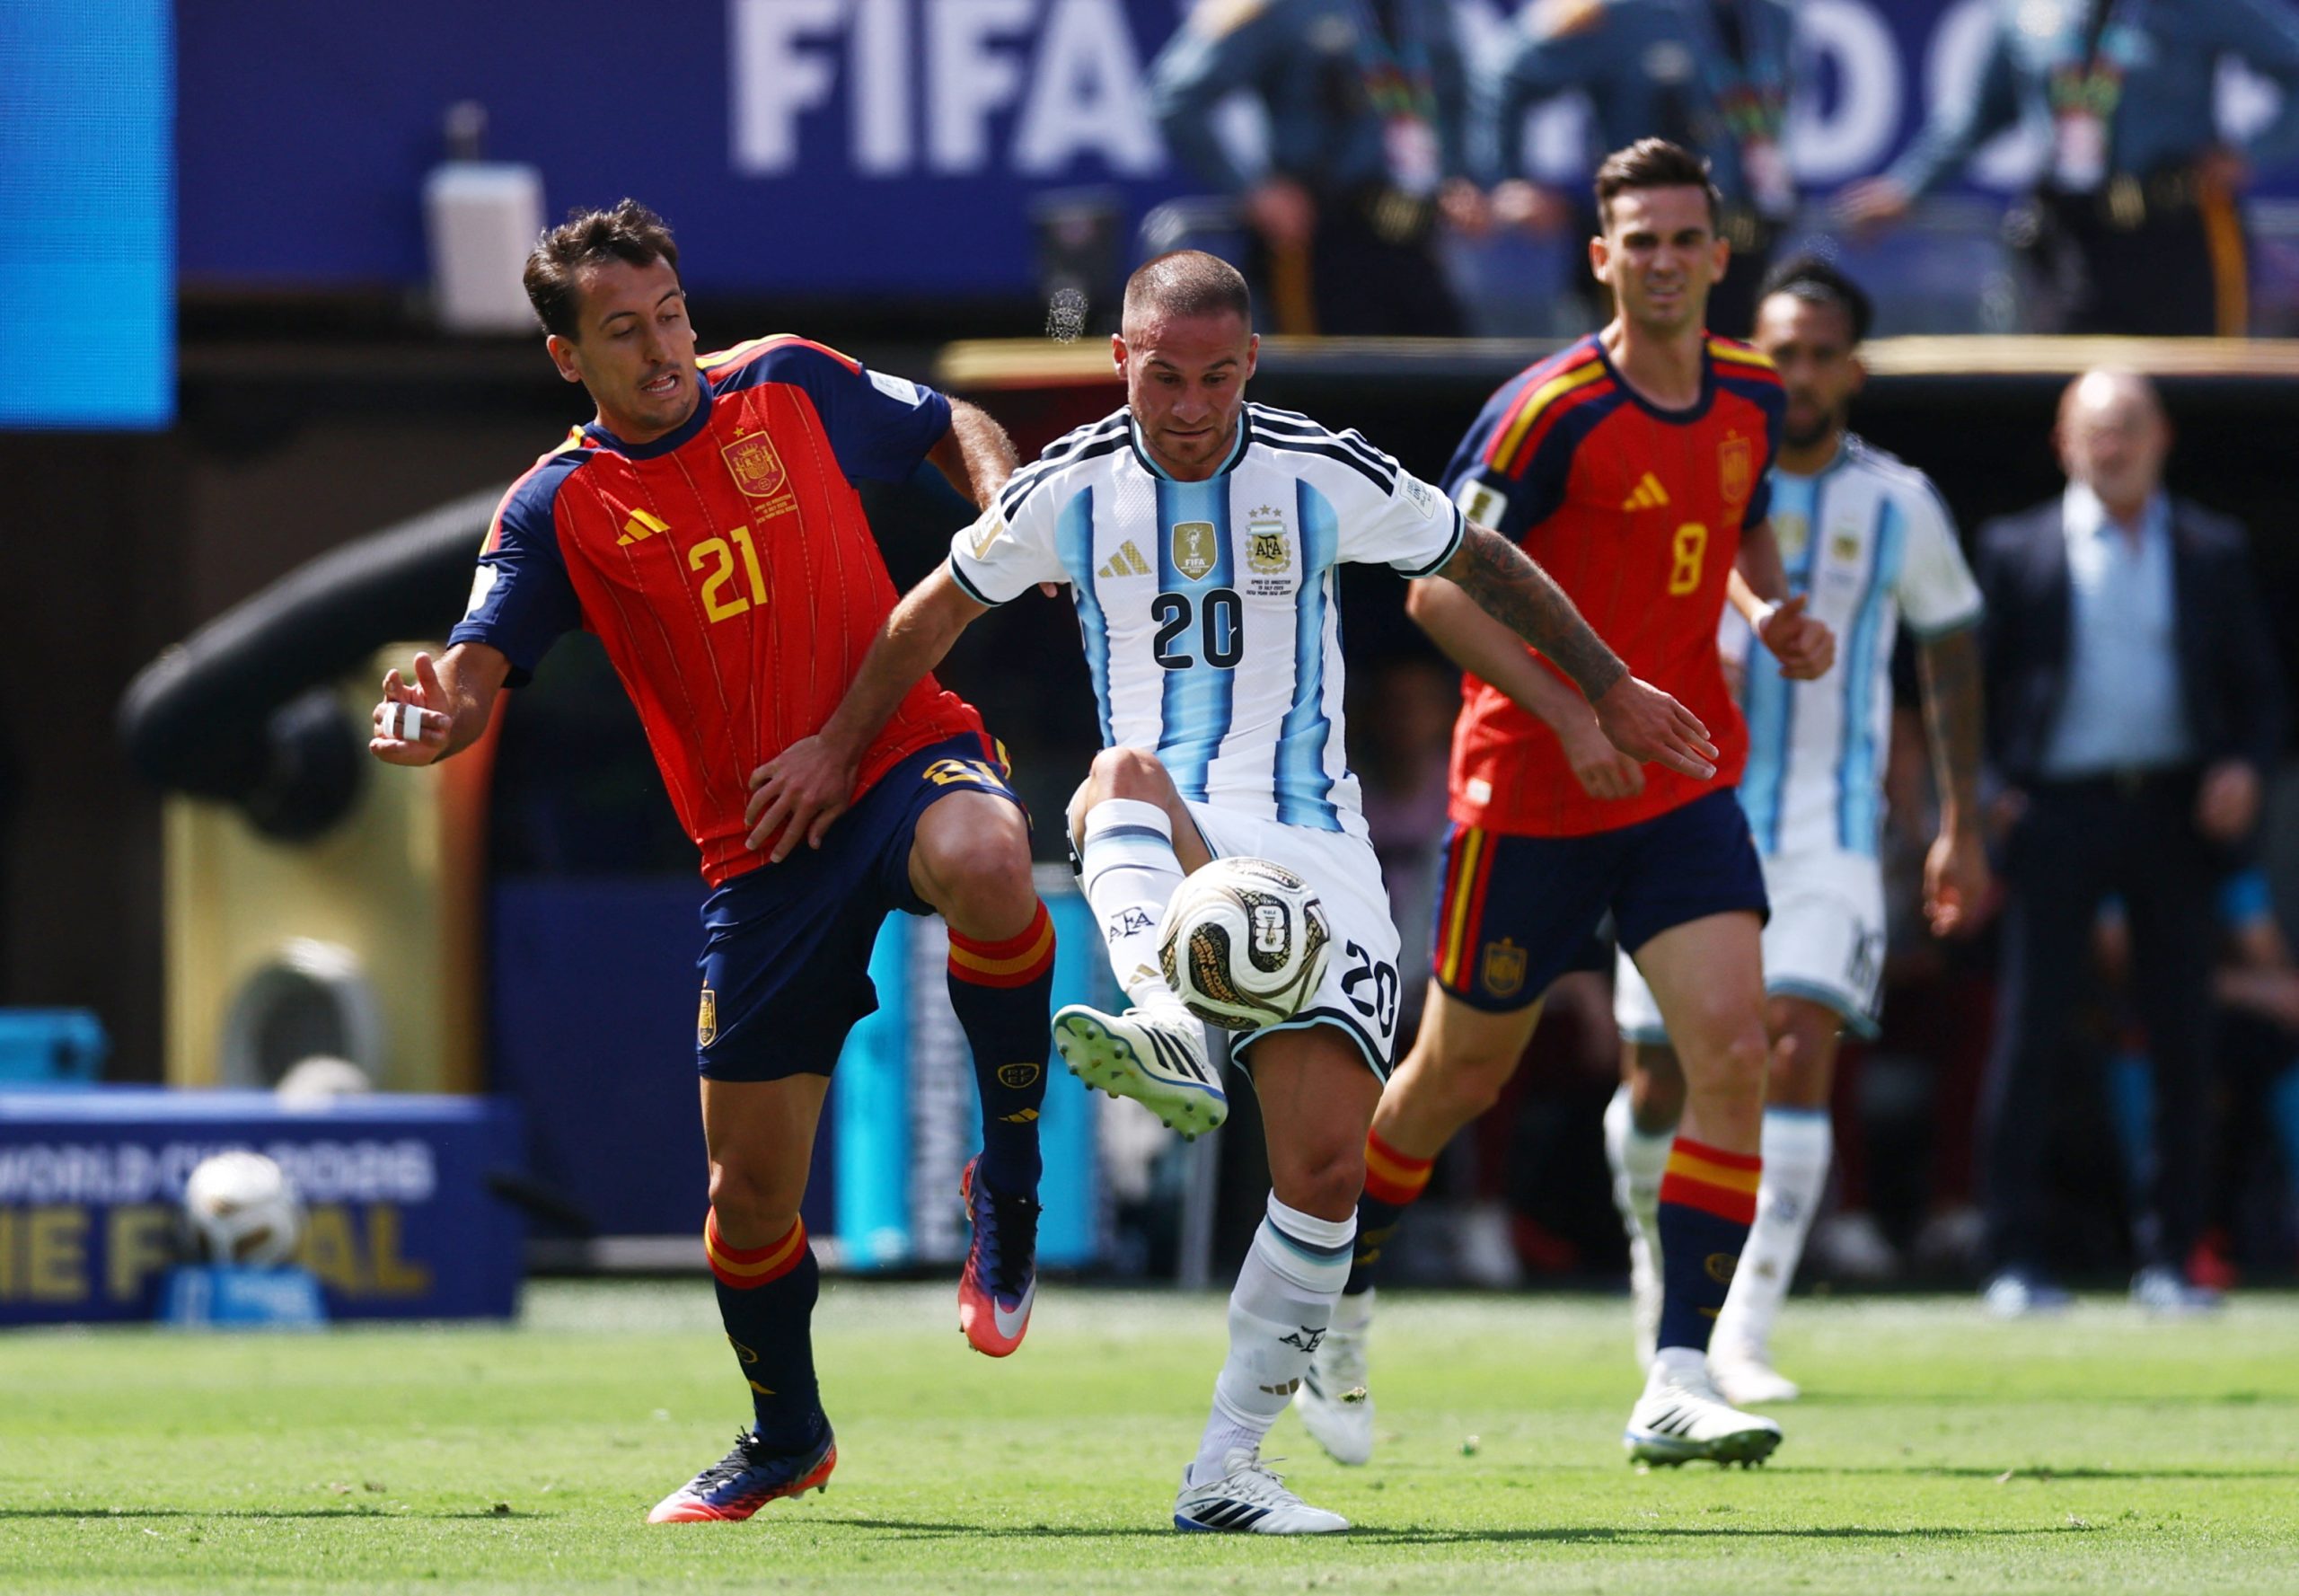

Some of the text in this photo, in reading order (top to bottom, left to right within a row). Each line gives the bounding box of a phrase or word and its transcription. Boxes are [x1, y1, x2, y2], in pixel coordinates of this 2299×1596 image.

[728, 0, 1167, 174] FIFA
[688, 525, 769, 623] 21
[1185, 559, 1205, 567] FIFA
[1255, 534, 1282, 560] AFA
[1668, 522, 1709, 596] 8
[1150, 587, 1243, 671] 20
[922, 759, 1005, 786] 21
[1109, 906, 1155, 944] AFA
[1190, 939, 1208, 964] NEW
[1196, 934, 1237, 1001] NEW YORK
[1341, 939, 1397, 1038] 20
[110, 1205, 430, 1299] FAL
